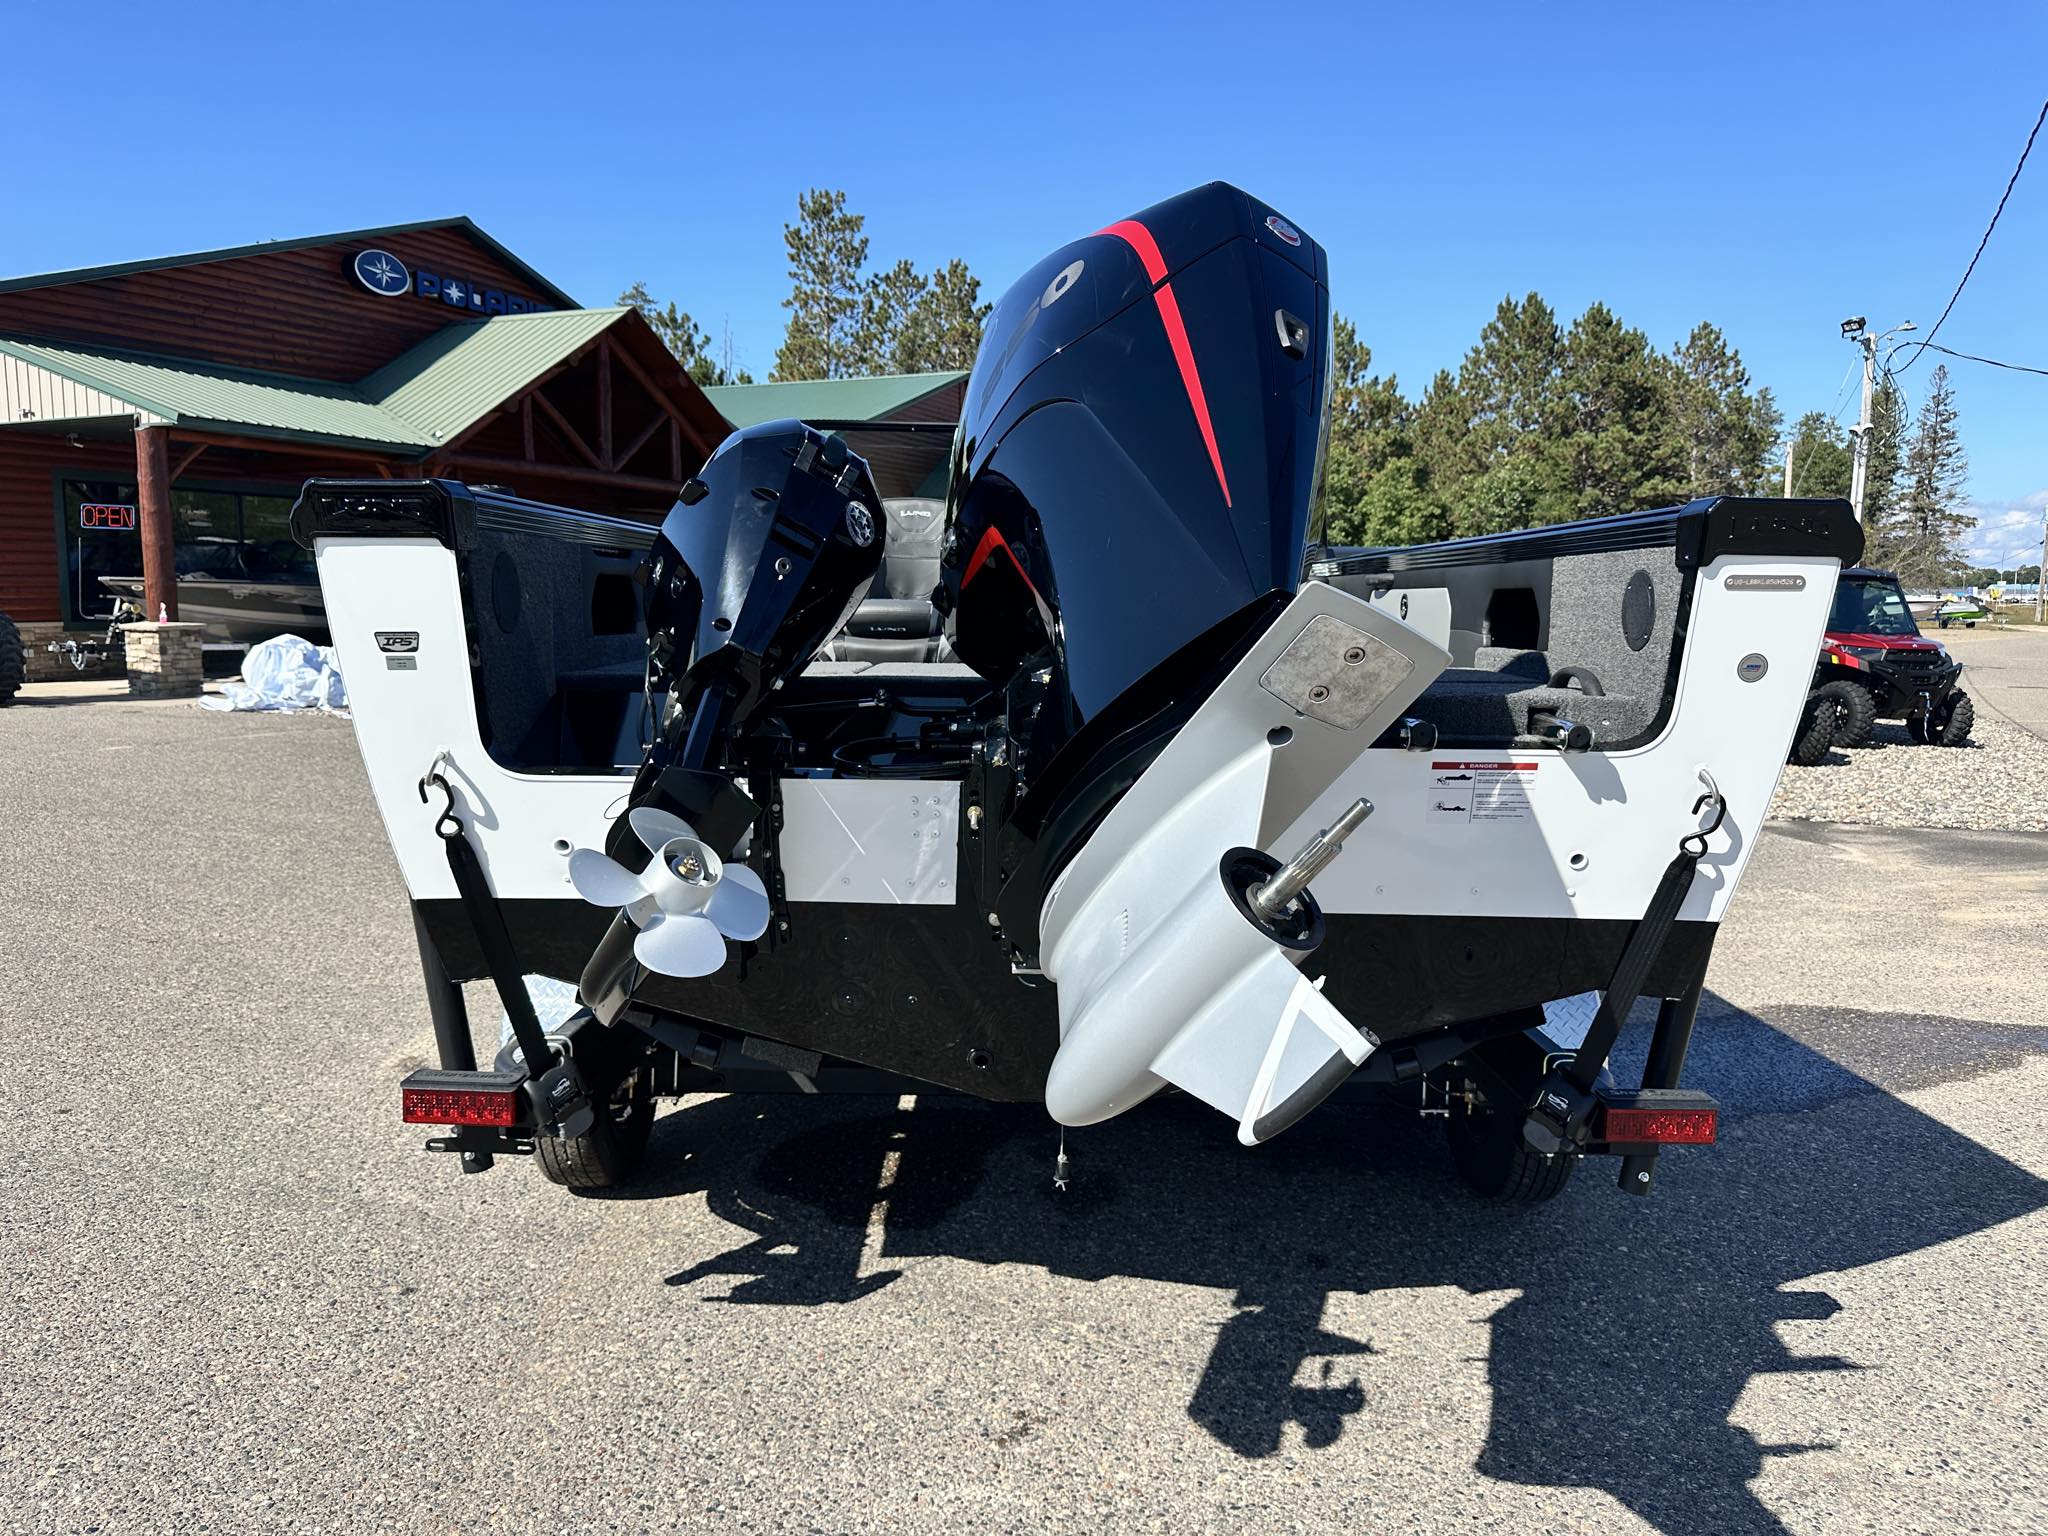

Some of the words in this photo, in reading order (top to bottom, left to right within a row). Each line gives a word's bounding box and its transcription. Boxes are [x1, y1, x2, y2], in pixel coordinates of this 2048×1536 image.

[414, 271, 553, 316] POLAR
[83, 506, 133, 528] OPEN
[900, 510, 931, 518] LUND
[382, 637, 413, 646] IPS
